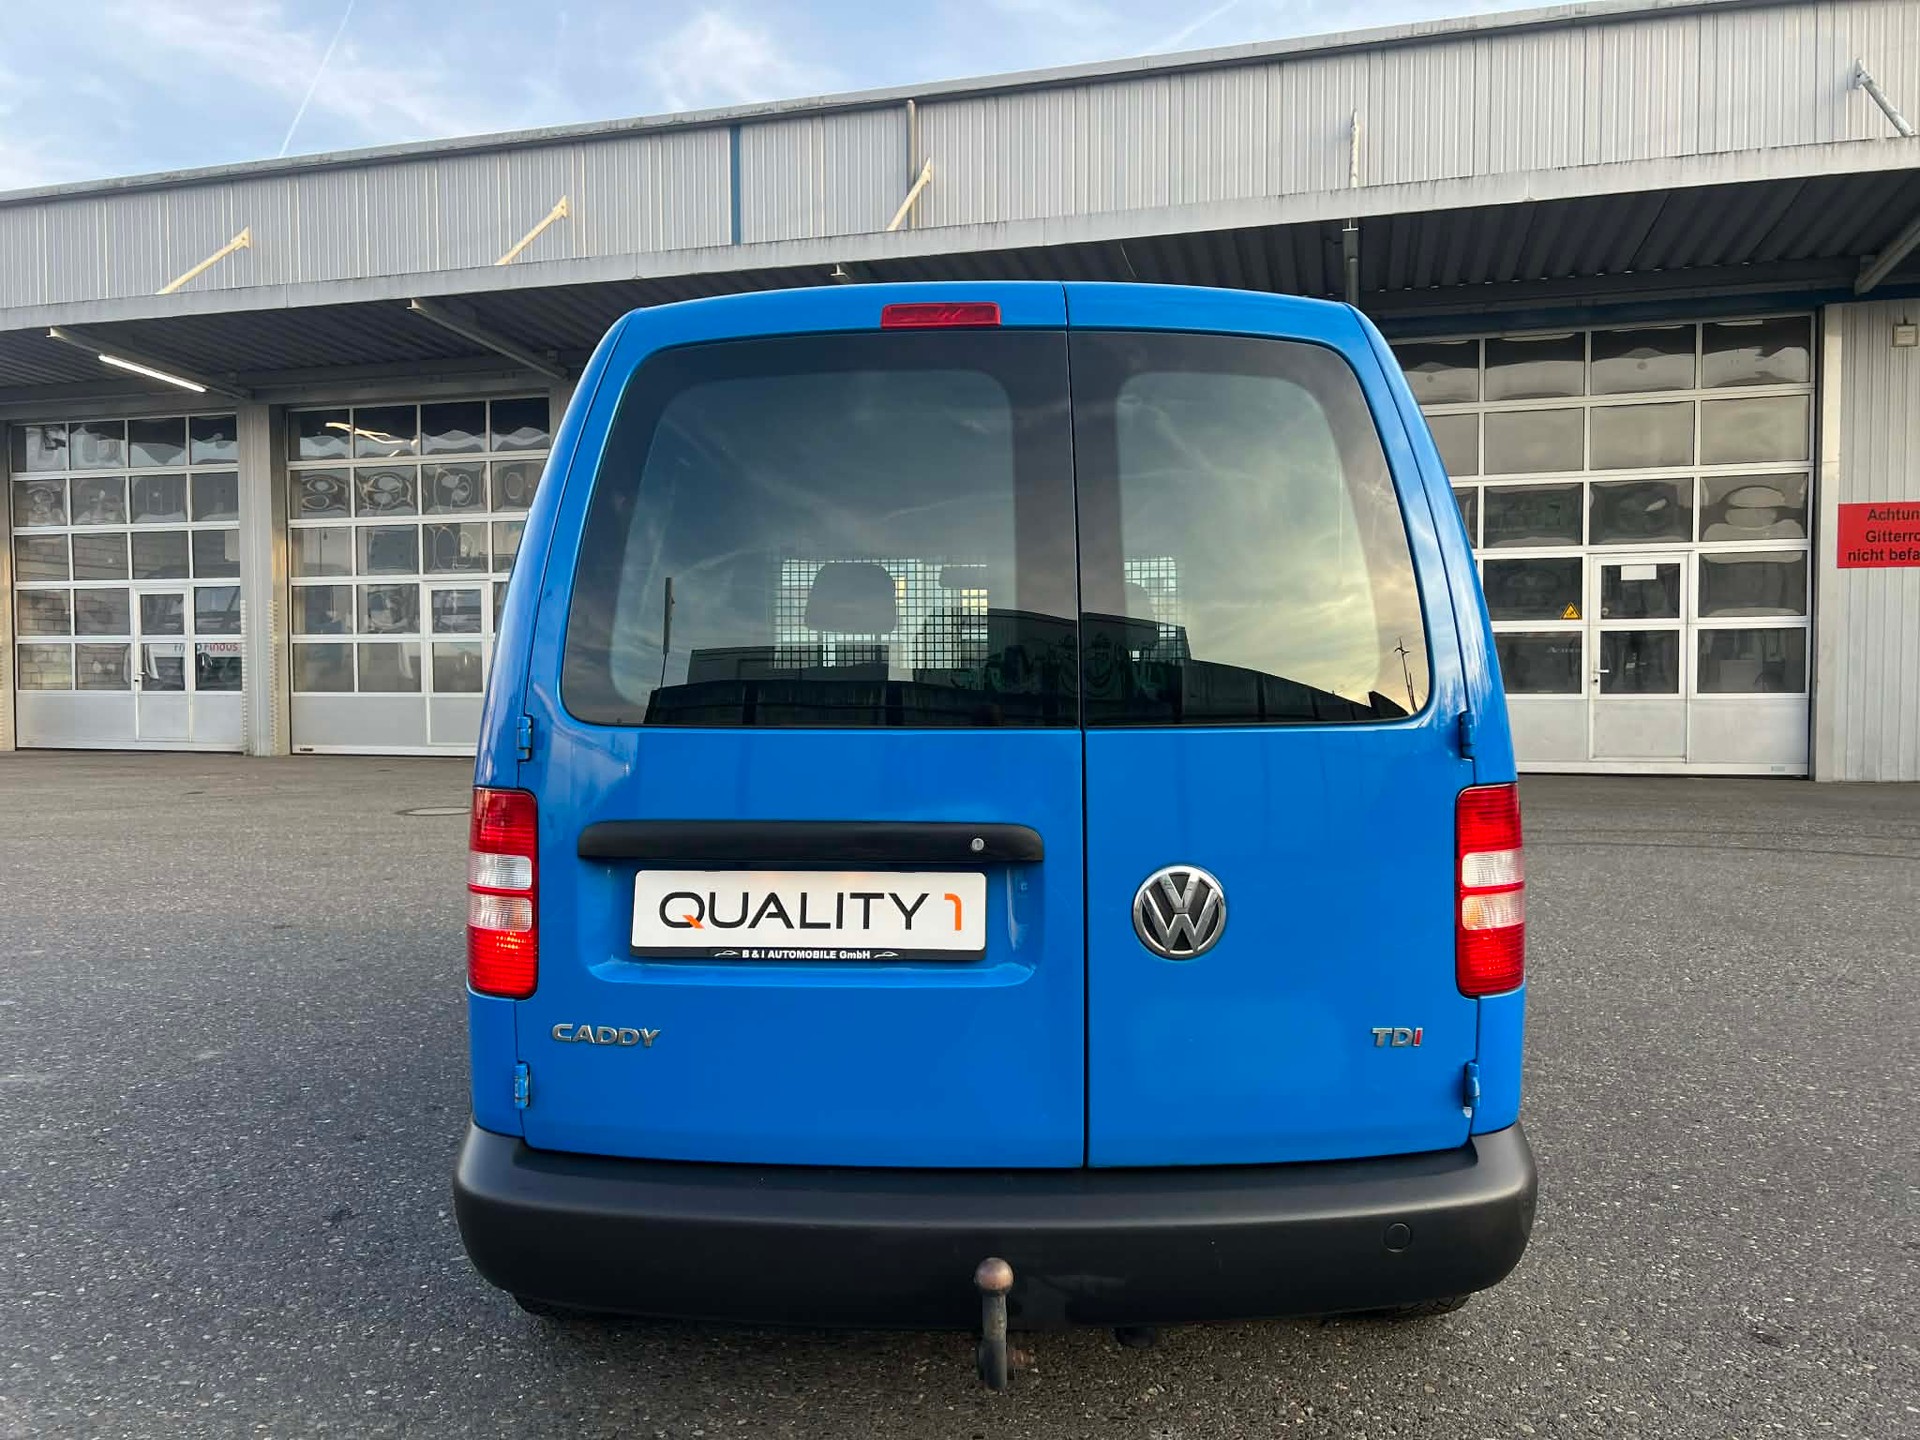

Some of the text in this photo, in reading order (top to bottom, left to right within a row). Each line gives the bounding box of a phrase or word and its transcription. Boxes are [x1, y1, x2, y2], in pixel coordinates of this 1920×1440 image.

[1847, 548, 1884, 562] nicht
[659, 891, 963, 931] QUALITY 1
[742, 950, 749, 959] B
[751, 950, 760, 959] &
[767, 950, 837, 959] AUTOMOBILE
[839, 950, 871, 960] GmbH
[552, 1023, 661, 1047] CADDY
[1372, 1027, 1424, 1047] TDI
